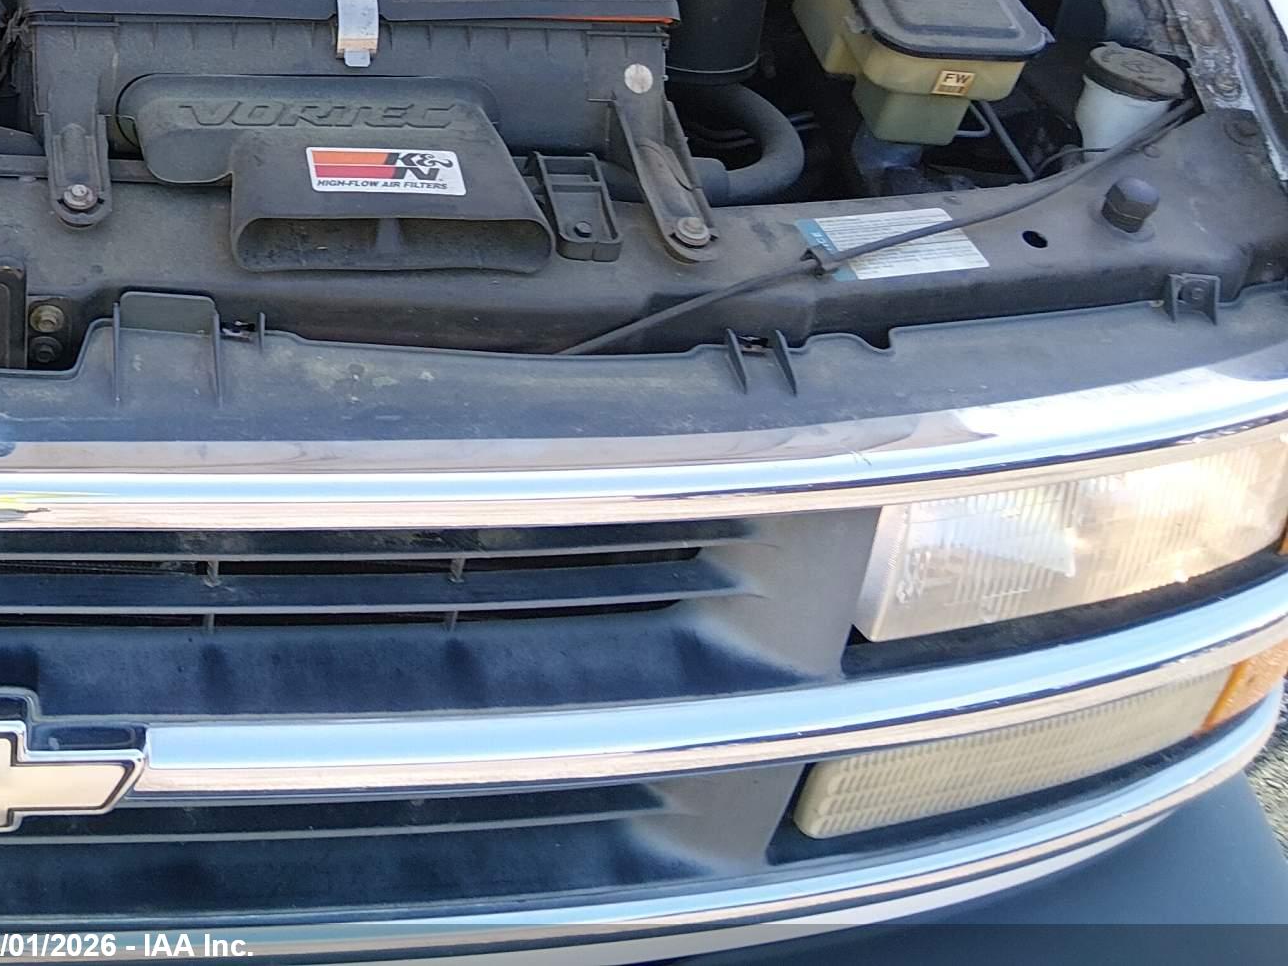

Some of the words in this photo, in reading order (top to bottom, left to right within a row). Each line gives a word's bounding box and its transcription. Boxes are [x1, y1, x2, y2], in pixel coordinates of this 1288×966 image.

[944, 73, 972, 84] FW
[178, 101, 456, 129] VORTEC
[384, 152, 454, 181] K&N
[317, 179, 379, 188] HIGH-FLOW
[403, 181, 449, 190] FILTERS
